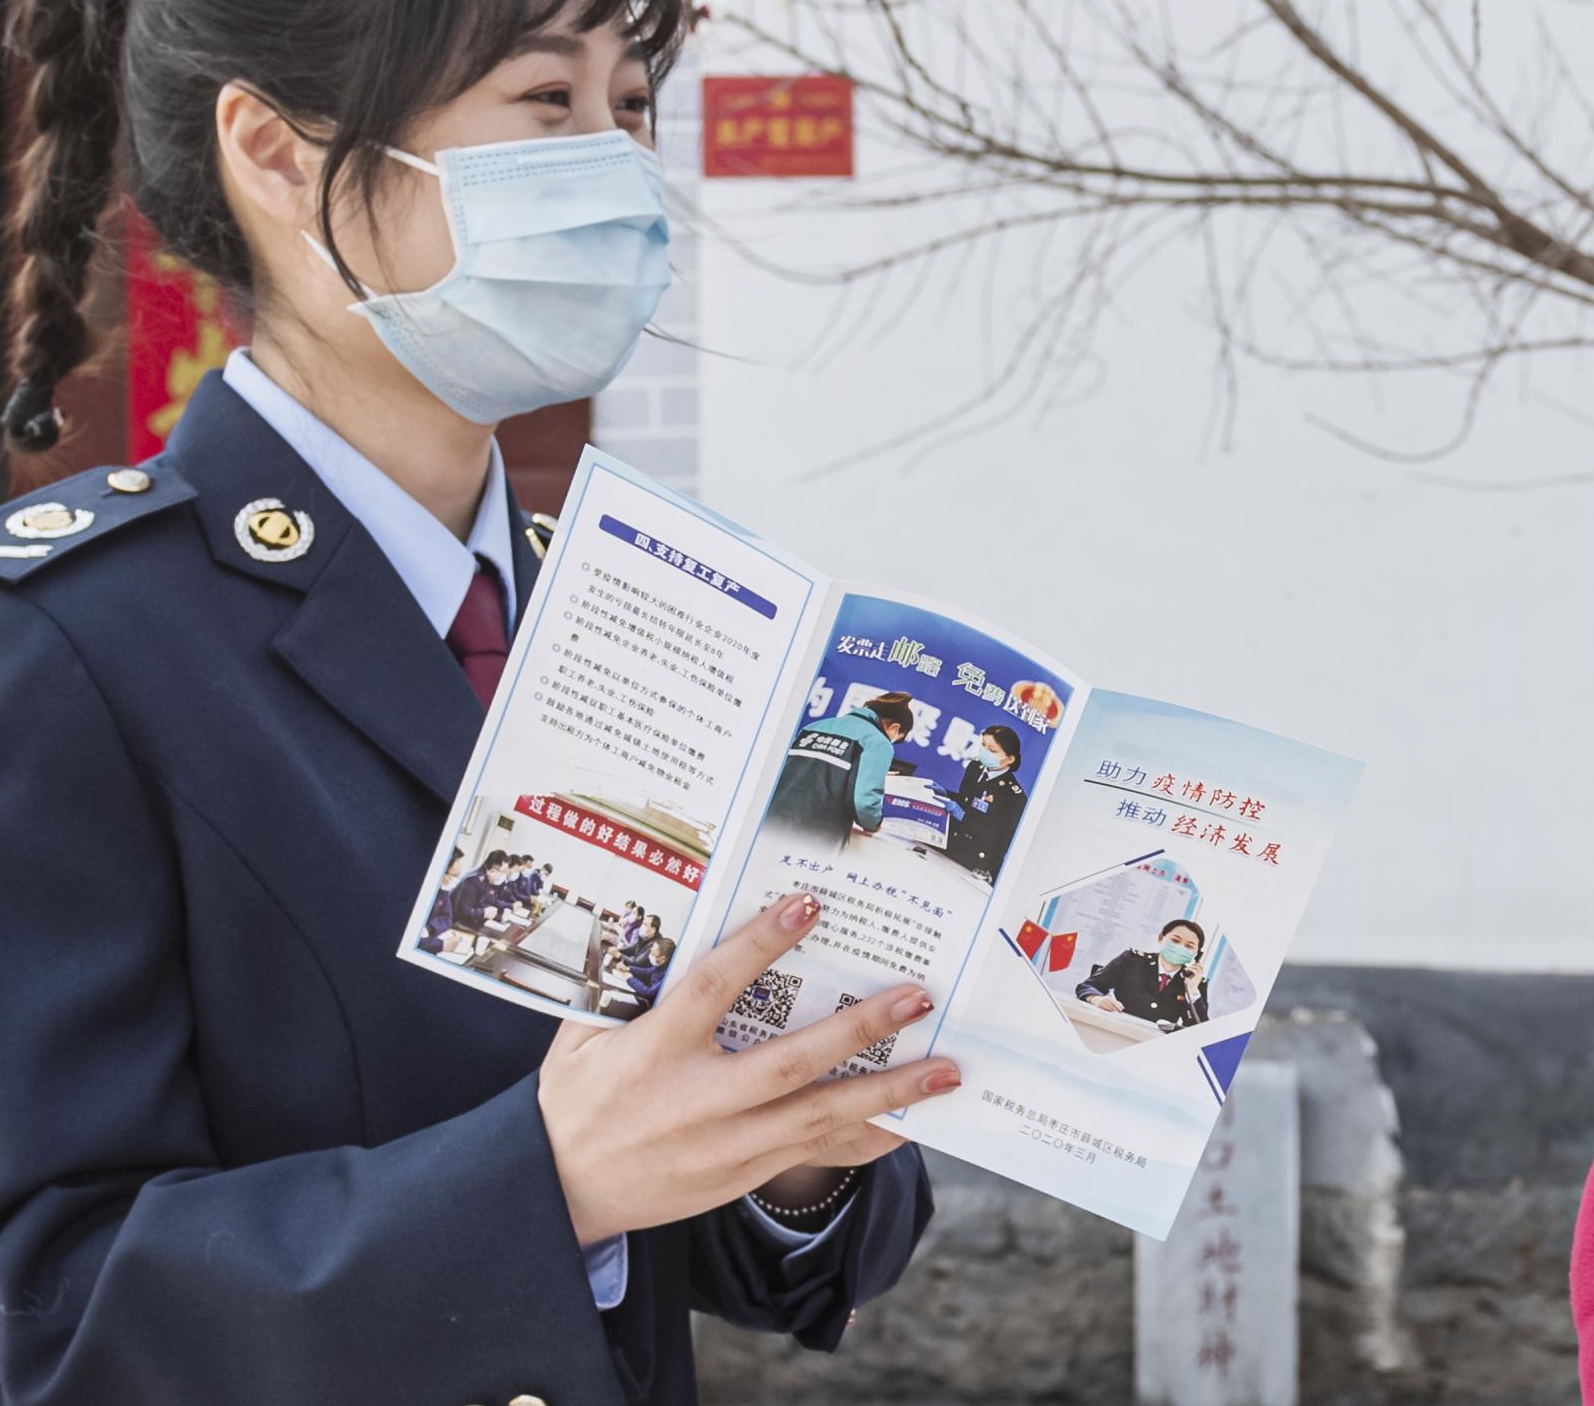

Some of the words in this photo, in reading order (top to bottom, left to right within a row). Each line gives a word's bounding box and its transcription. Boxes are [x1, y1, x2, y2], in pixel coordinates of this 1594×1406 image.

[634, 532, 740, 595] 四、支持复工复产
[528, 796, 700, 883] 过程做的好结果必然好
[779, 854, 834, 874] 足不出户
[982, 1089, 1147, 1169] 国家税务总局枣庄市薛城区税务局
